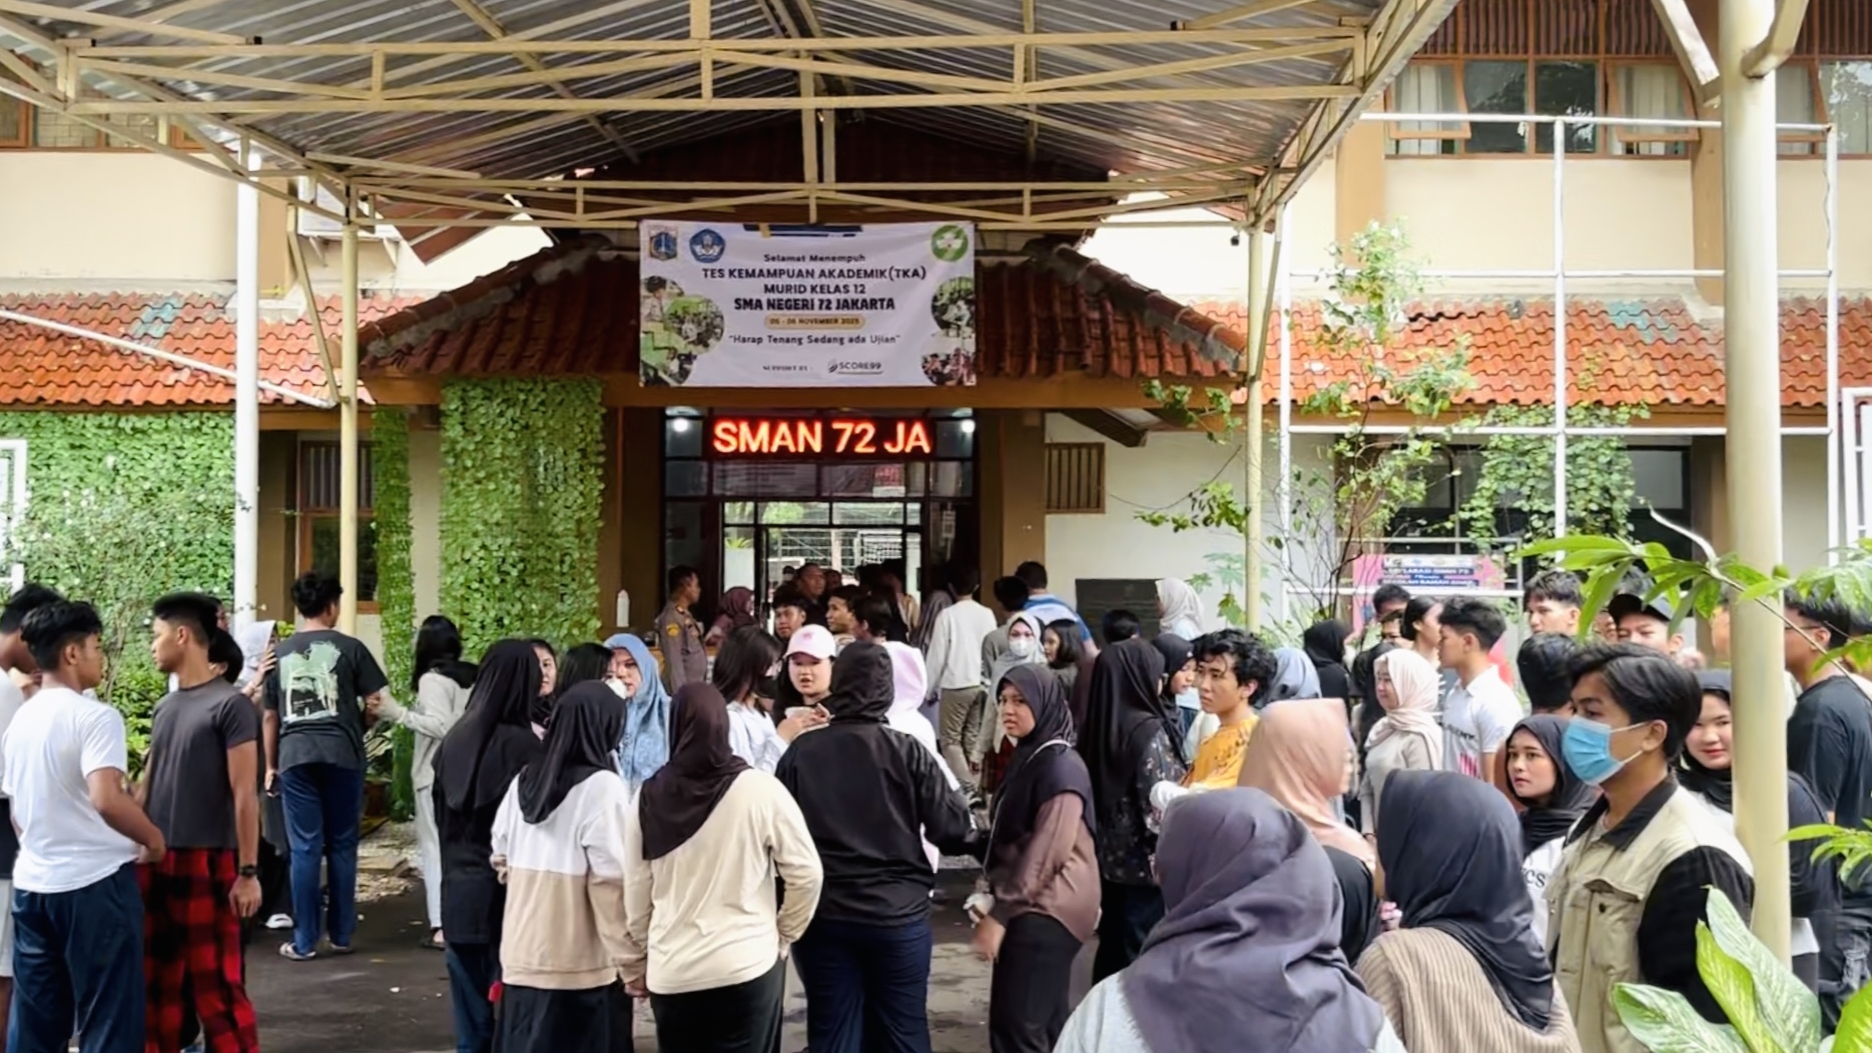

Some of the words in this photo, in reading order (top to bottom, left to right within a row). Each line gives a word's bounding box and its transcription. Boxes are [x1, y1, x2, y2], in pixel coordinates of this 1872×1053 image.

[764, 254, 805, 262] Selamat
[809, 254, 866, 263] Menempuh
[702, 268, 725, 279] TES
[728, 268, 815, 279] KEMAMPUAN
[818, 265, 927, 281] AKADEMIK(TKA)
[764, 284, 807, 294] MURID
[810, 284, 850, 294] KELAS
[854, 284, 866, 294] 12
[734, 298, 763, 311] SMA
[766, 298, 815, 311] NEGERI
[818, 298, 832, 311] 72
[835, 298, 895, 311] JAKARTA
[767, 335, 803, 346] Tenang
[807, 335, 845, 346] Sedang
[848, 335, 866, 344] ada
[713, 421, 822, 453] SMAN
[832, 421, 876, 453] 72
[884, 421, 931, 453] JA
